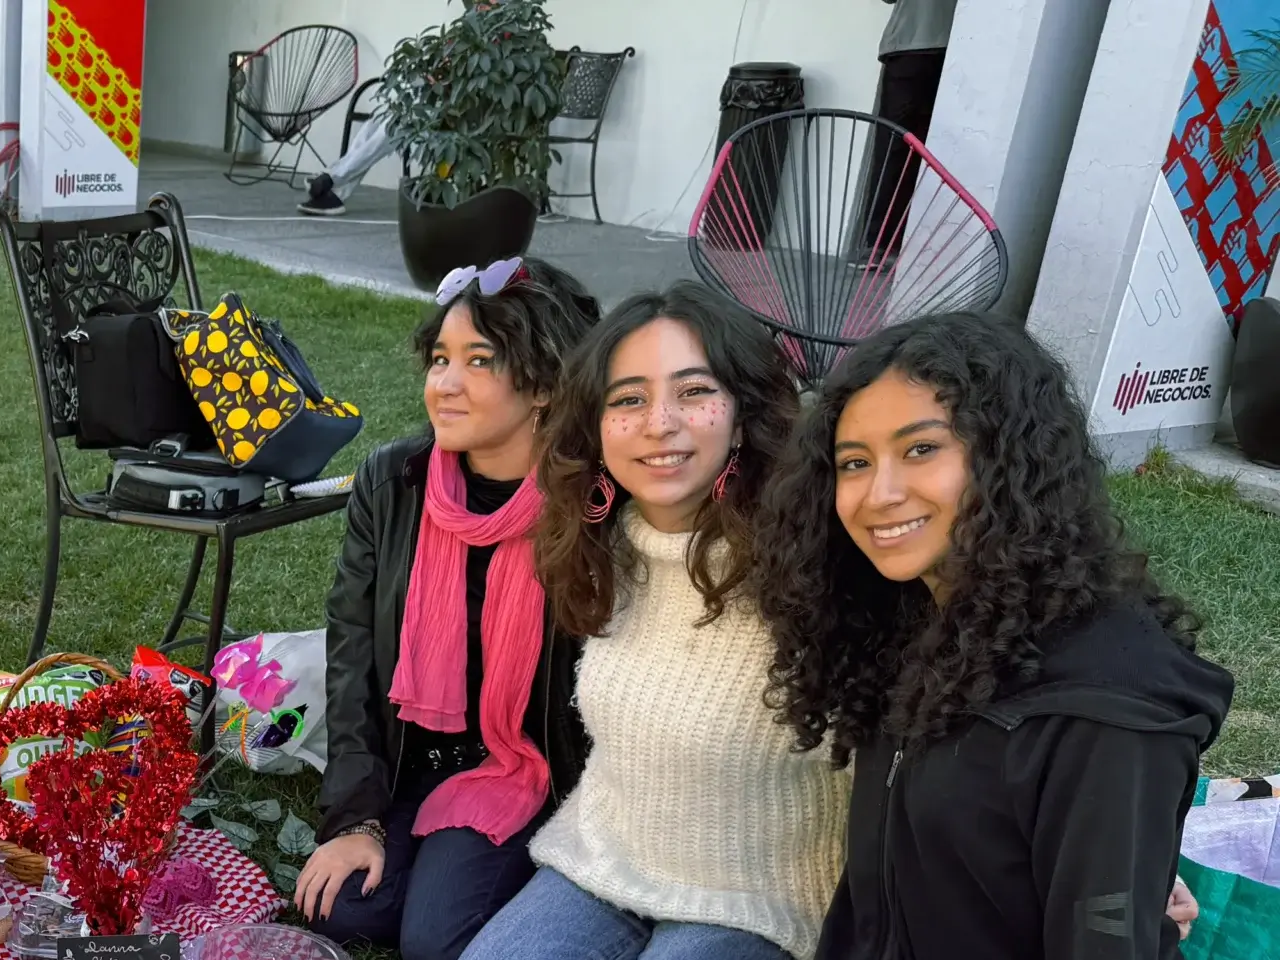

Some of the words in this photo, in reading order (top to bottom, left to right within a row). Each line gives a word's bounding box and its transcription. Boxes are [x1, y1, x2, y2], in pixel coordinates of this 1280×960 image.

[76, 174, 102, 183] LIBRE
[104, 173, 117, 182] DE
[76, 184, 124, 193] NEGOCIOS.
[1149, 368, 1189, 386] LIBRE
[1188, 366, 1210, 383] DE
[1143, 384, 1212, 405] NEGOCIOS.
[84, 941, 142, 953] Danna
